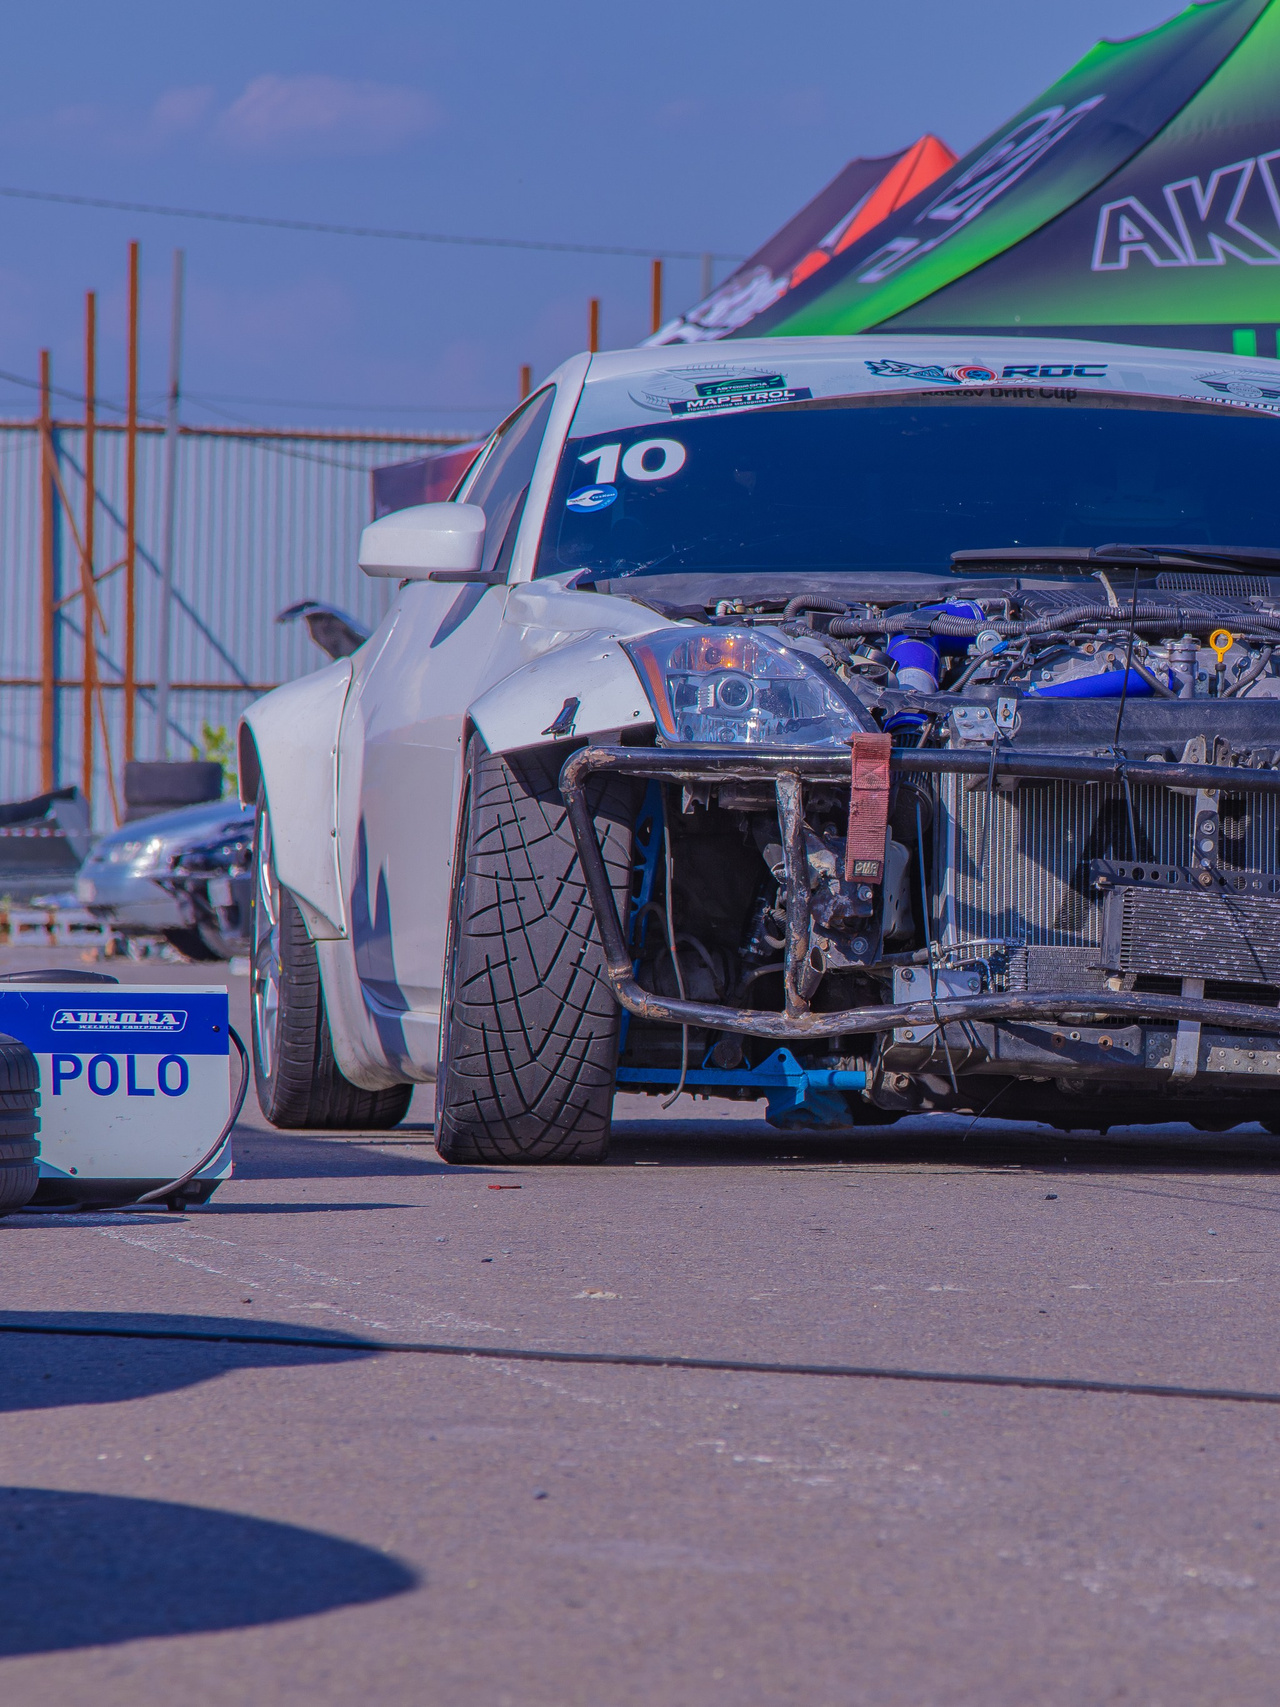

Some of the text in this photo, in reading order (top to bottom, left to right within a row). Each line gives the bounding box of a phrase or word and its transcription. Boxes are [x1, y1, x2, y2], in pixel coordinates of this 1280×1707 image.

[686, 390, 796, 408] MAPETROL
[990, 386, 1034, 399] Drift
[1038, 387, 1077, 402] Cup
[577, 438, 687, 484] 10
[56, 1012, 180, 1025] AURORA
[51, 1053, 190, 1097] POLO
